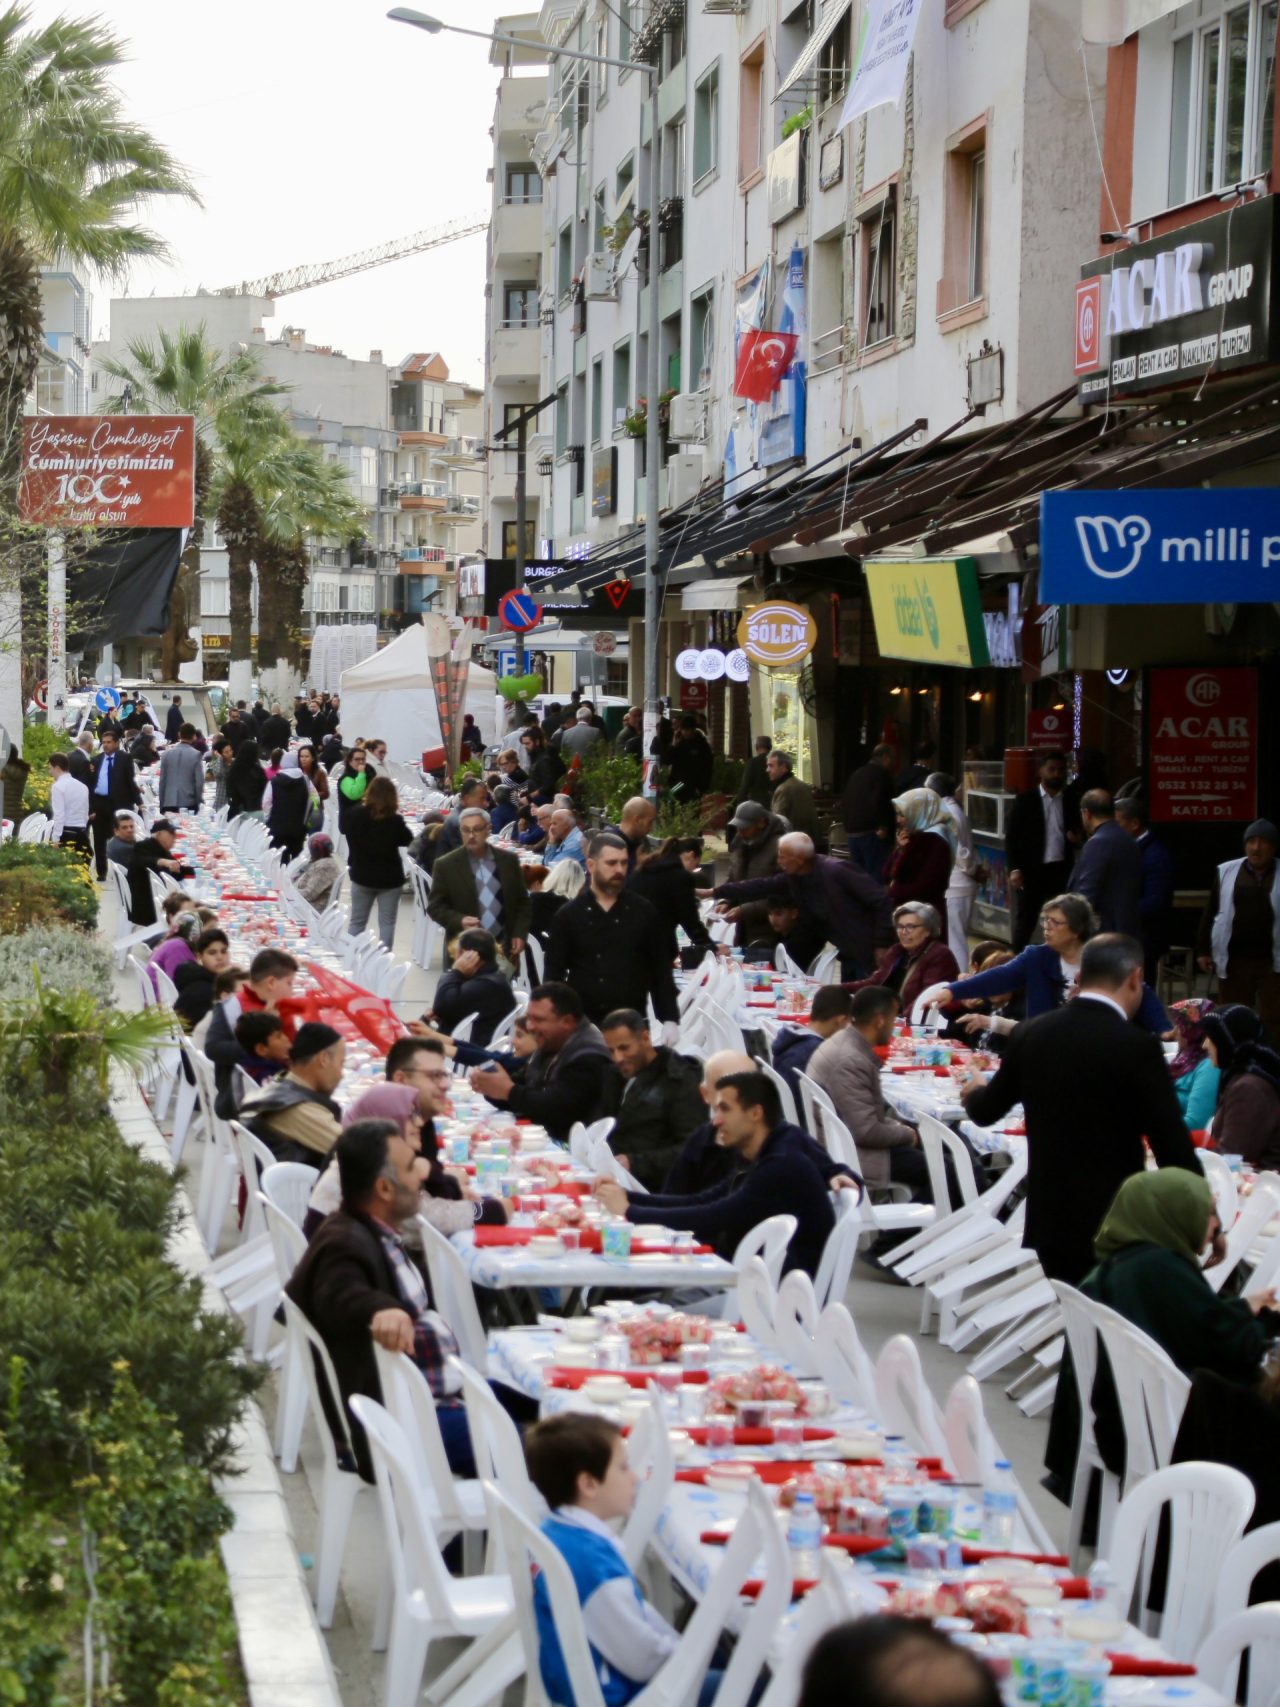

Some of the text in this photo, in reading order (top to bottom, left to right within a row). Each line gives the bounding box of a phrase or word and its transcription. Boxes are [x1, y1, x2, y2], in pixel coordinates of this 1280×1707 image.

[1106, 243, 1253, 336] ACAR GROUP
[1182, 341, 1217, 366] NAKLİYAT
[1222, 331, 1250, 358] TURİZM
[1113, 359, 1135, 380] EMLAK
[1139, 352, 1178, 373] RENT A CAR
[30, 422, 87, 453] Yaşasın
[29, 454, 174, 473] Cumhuriyetimizin
[1161, 528, 1250, 562] milli
[748, 619, 807, 644] SÖLEN
[1155, 717, 1249, 738] ACAR
[1211, 741, 1250, 749] GROUP
